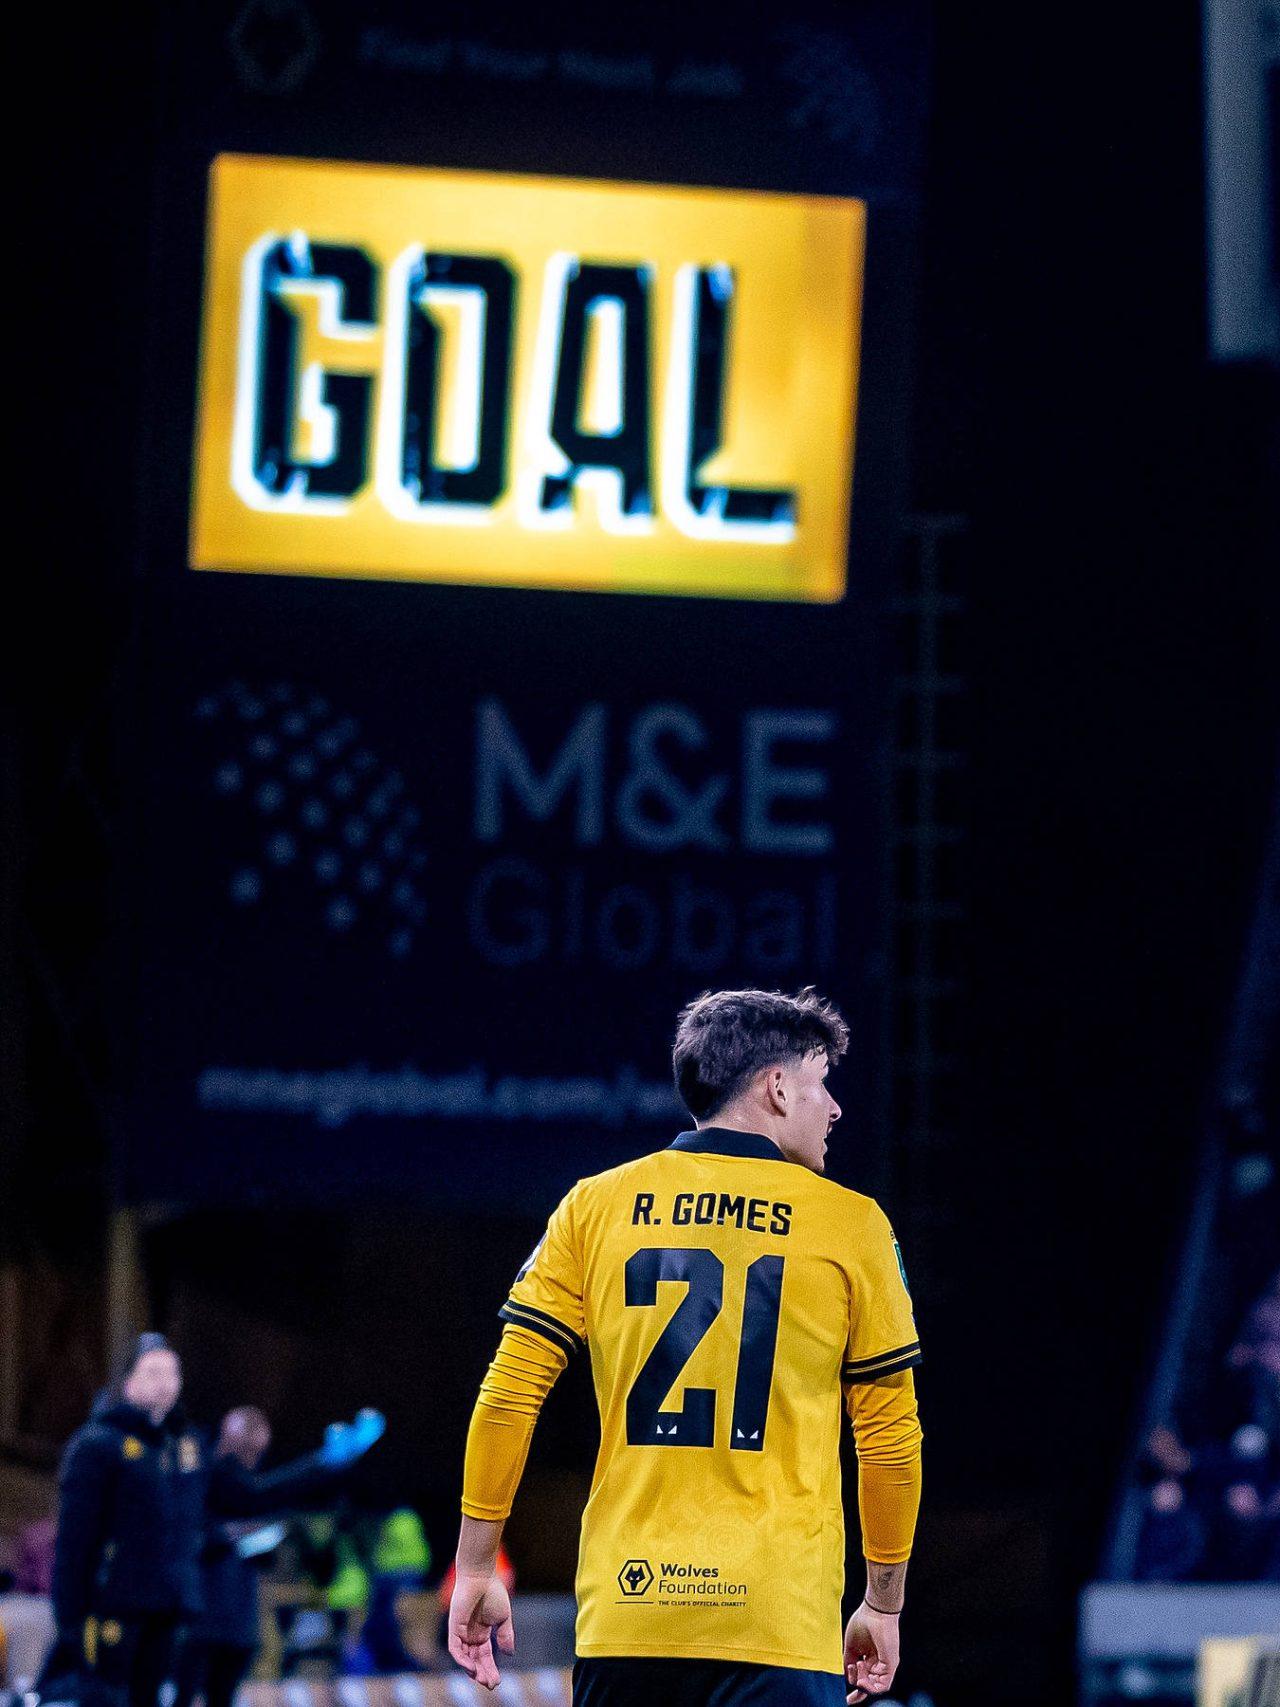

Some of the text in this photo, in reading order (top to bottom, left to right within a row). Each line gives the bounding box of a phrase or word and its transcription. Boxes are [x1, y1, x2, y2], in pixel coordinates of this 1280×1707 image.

[231, 230, 798, 545] GOAL
[472, 698, 838, 856] M&E
[466, 856, 838, 974] Global
[631, 1192, 793, 1236] R. GOMES
[625, 1248, 785, 1451] 21
[658, 1579, 748, 1595] Foundation
[660, 1563, 719, 1578] Wolves
